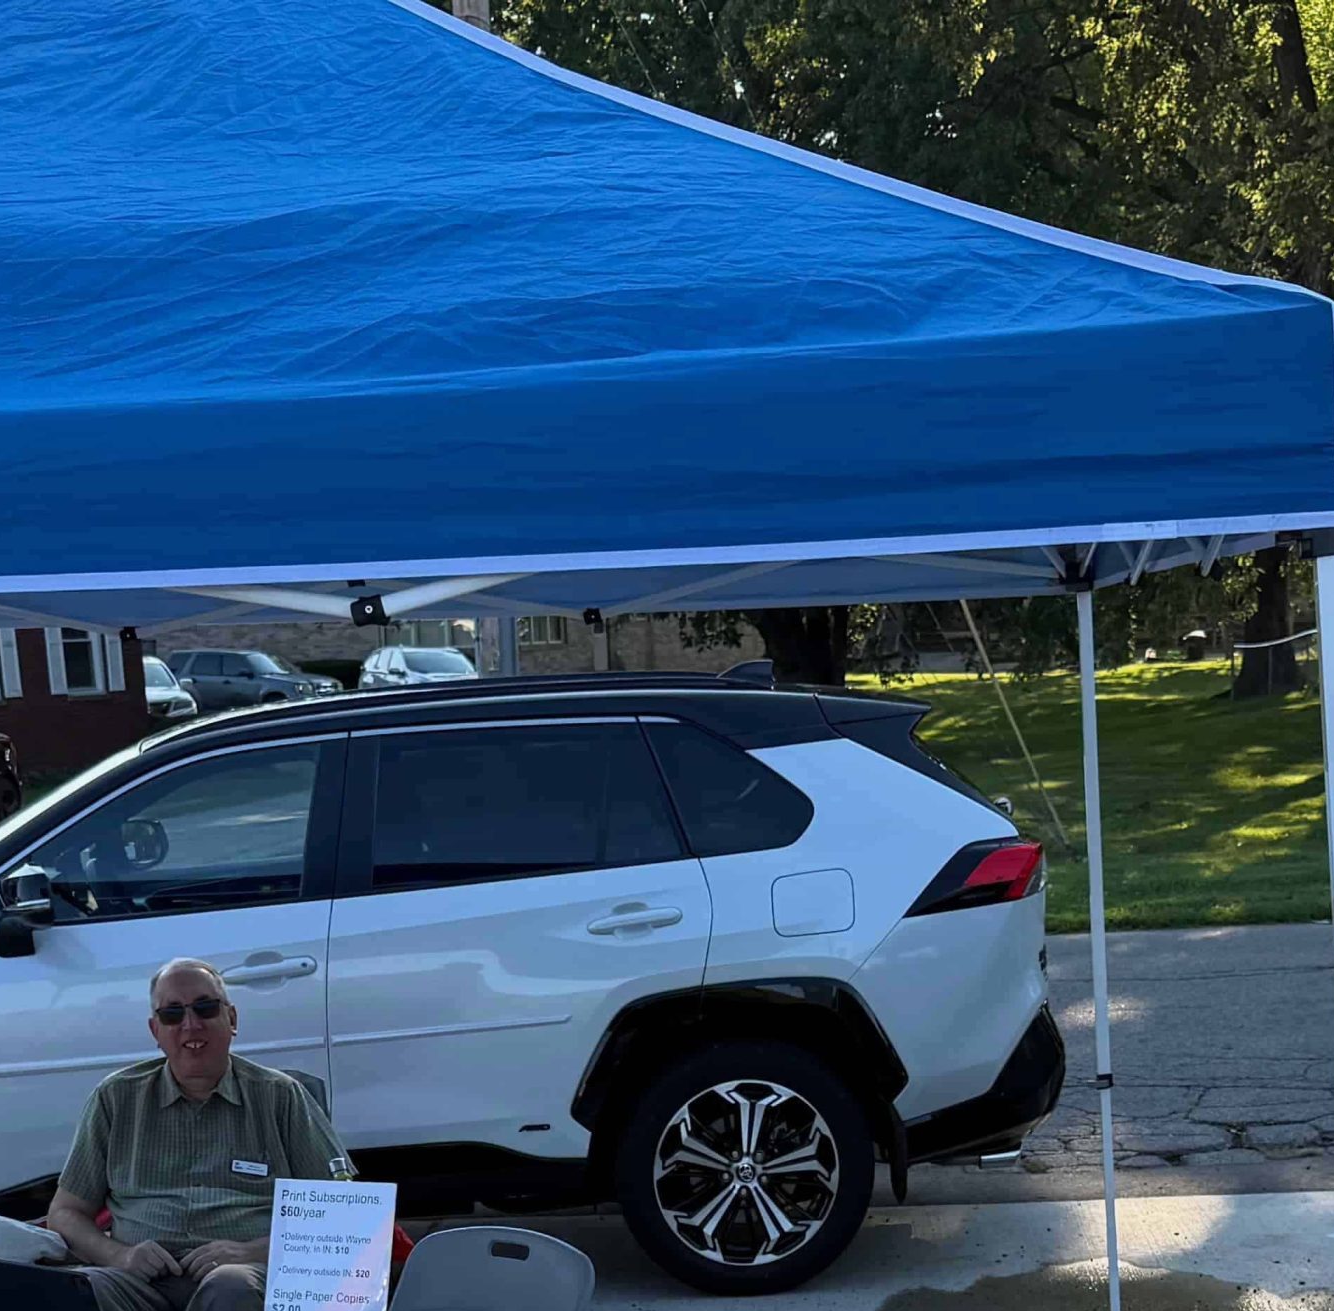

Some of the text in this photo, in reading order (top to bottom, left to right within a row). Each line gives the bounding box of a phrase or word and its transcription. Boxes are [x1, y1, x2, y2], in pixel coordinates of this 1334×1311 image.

[282, 1190, 306, 1201] Print
[280, 1205, 326, 1220] $60/year
[335, 1246, 350, 1255] $10
[355, 1269, 370, 1278] $20
[273, 1289, 370, 1304] Single Paper Copies
